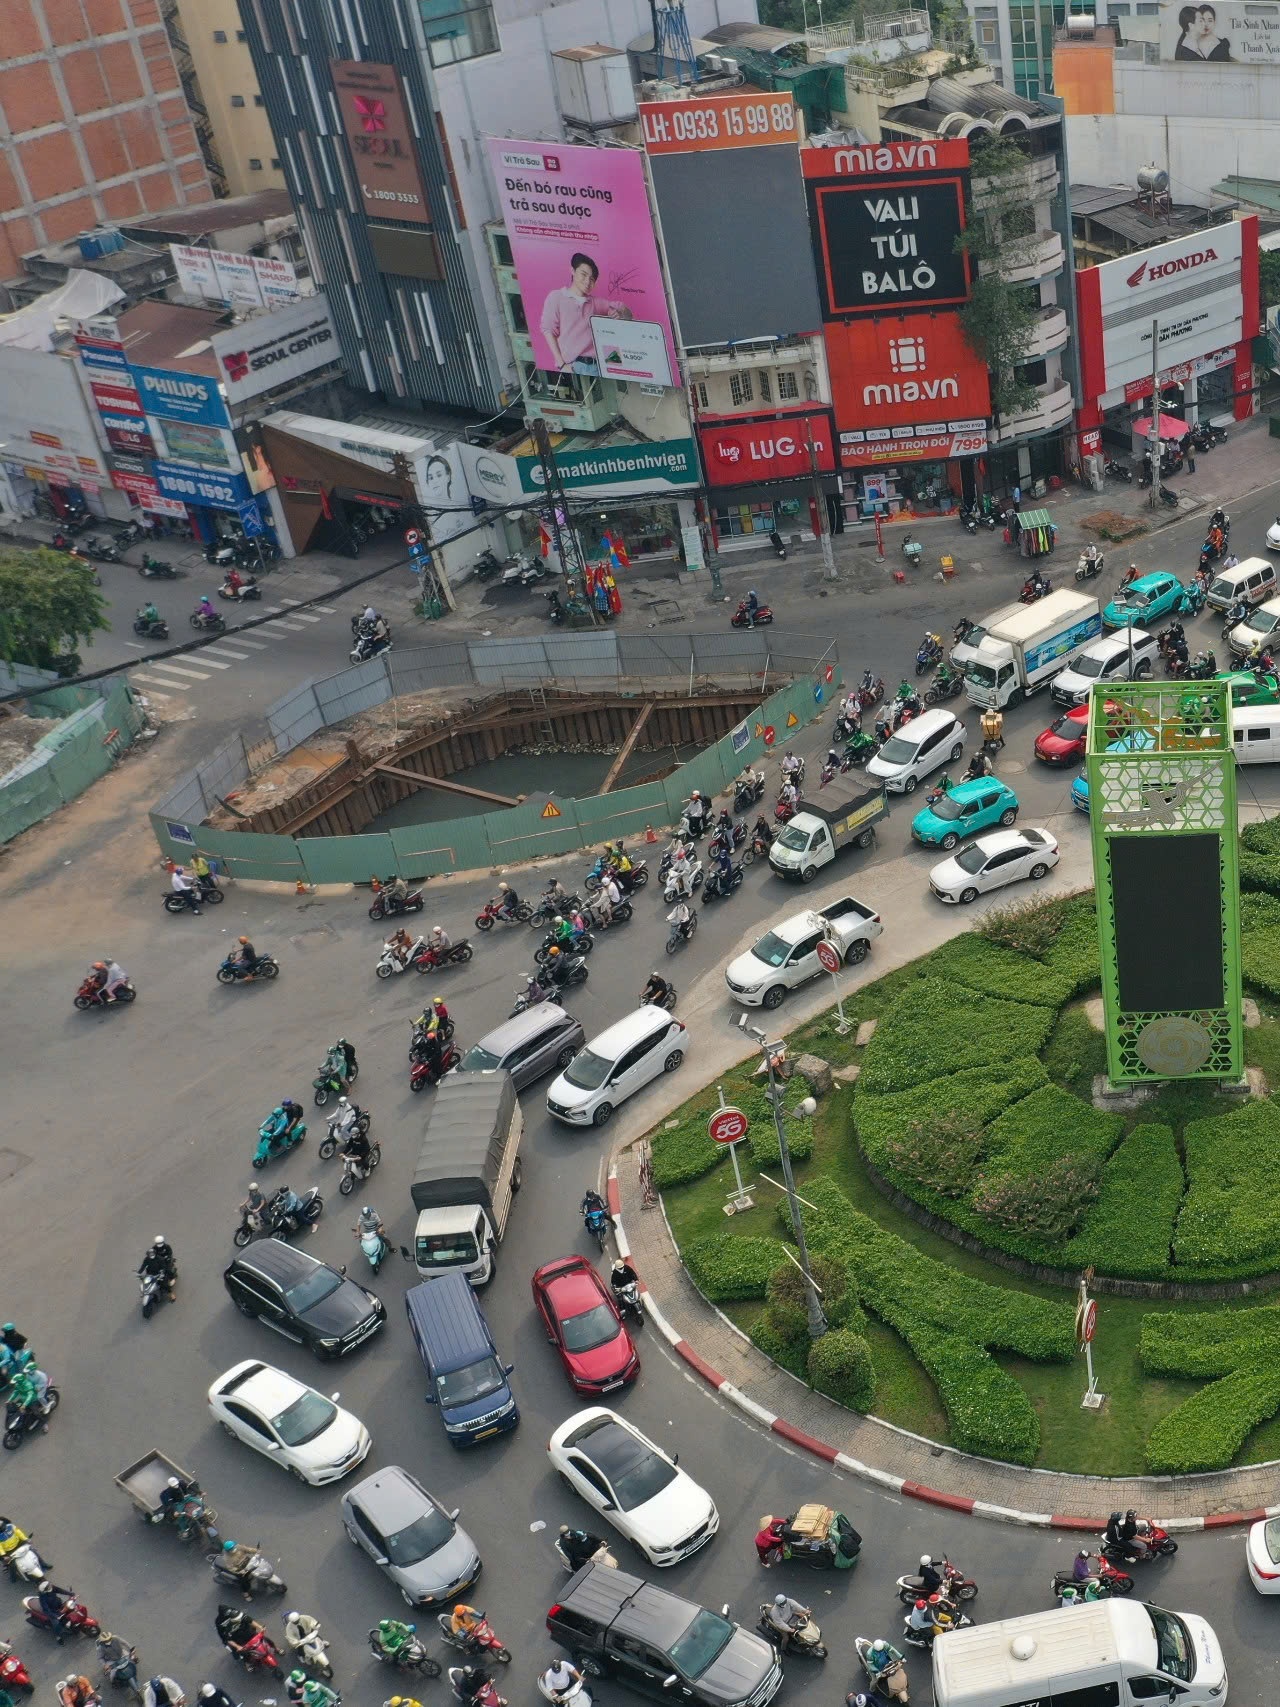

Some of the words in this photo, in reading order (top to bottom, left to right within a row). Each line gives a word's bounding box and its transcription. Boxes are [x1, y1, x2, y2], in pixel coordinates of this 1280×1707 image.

[1241, 42, 1264, 54] Thanh
[642, 113, 671, 144] LH:
[673, 108, 719, 142] 0933
[722, 106, 742, 137] 15
[747, 105, 768, 134] 99
[771, 102, 794, 132] 88
[527, 157, 540, 166] Sau
[834, 144, 937, 174] mia.vn
[374, 190, 396, 201] 1800
[505, 178, 532, 192] Đến
[536, 181, 551, 194] bó
[555, 185, 577, 197] rau
[580, 185, 613, 203] cũng
[510, 197, 530, 212] trả
[533, 203, 555, 214] sau
[558, 203, 592, 220] được
[864, 196, 919, 223] VALI
[870, 228, 917, 260] TÚI
[861, 260, 937, 294] BALÔ
[1148, 248, 1218, 282] HONDA
[250, 348, 289, 372] SEOUL
[288, 328, 332, 355] CENTER
[143, 375, 208, 401] PHILIPS
[863, 377, 959, 406] mia.vn
[96, 396, 140, 412] TOSHIBA
[866, 441, 898, 454] HÀNH
[899, 440, 929, 451] TRỌN
[930, 437, 949, 448] ĐỜI
[557, 451, 686, 479] matkinhbenhvien
[159, 475, 197, 495] 1800
[197, 482, 236, 502] 1592
[716, 1120, 742, 1139] 5G
